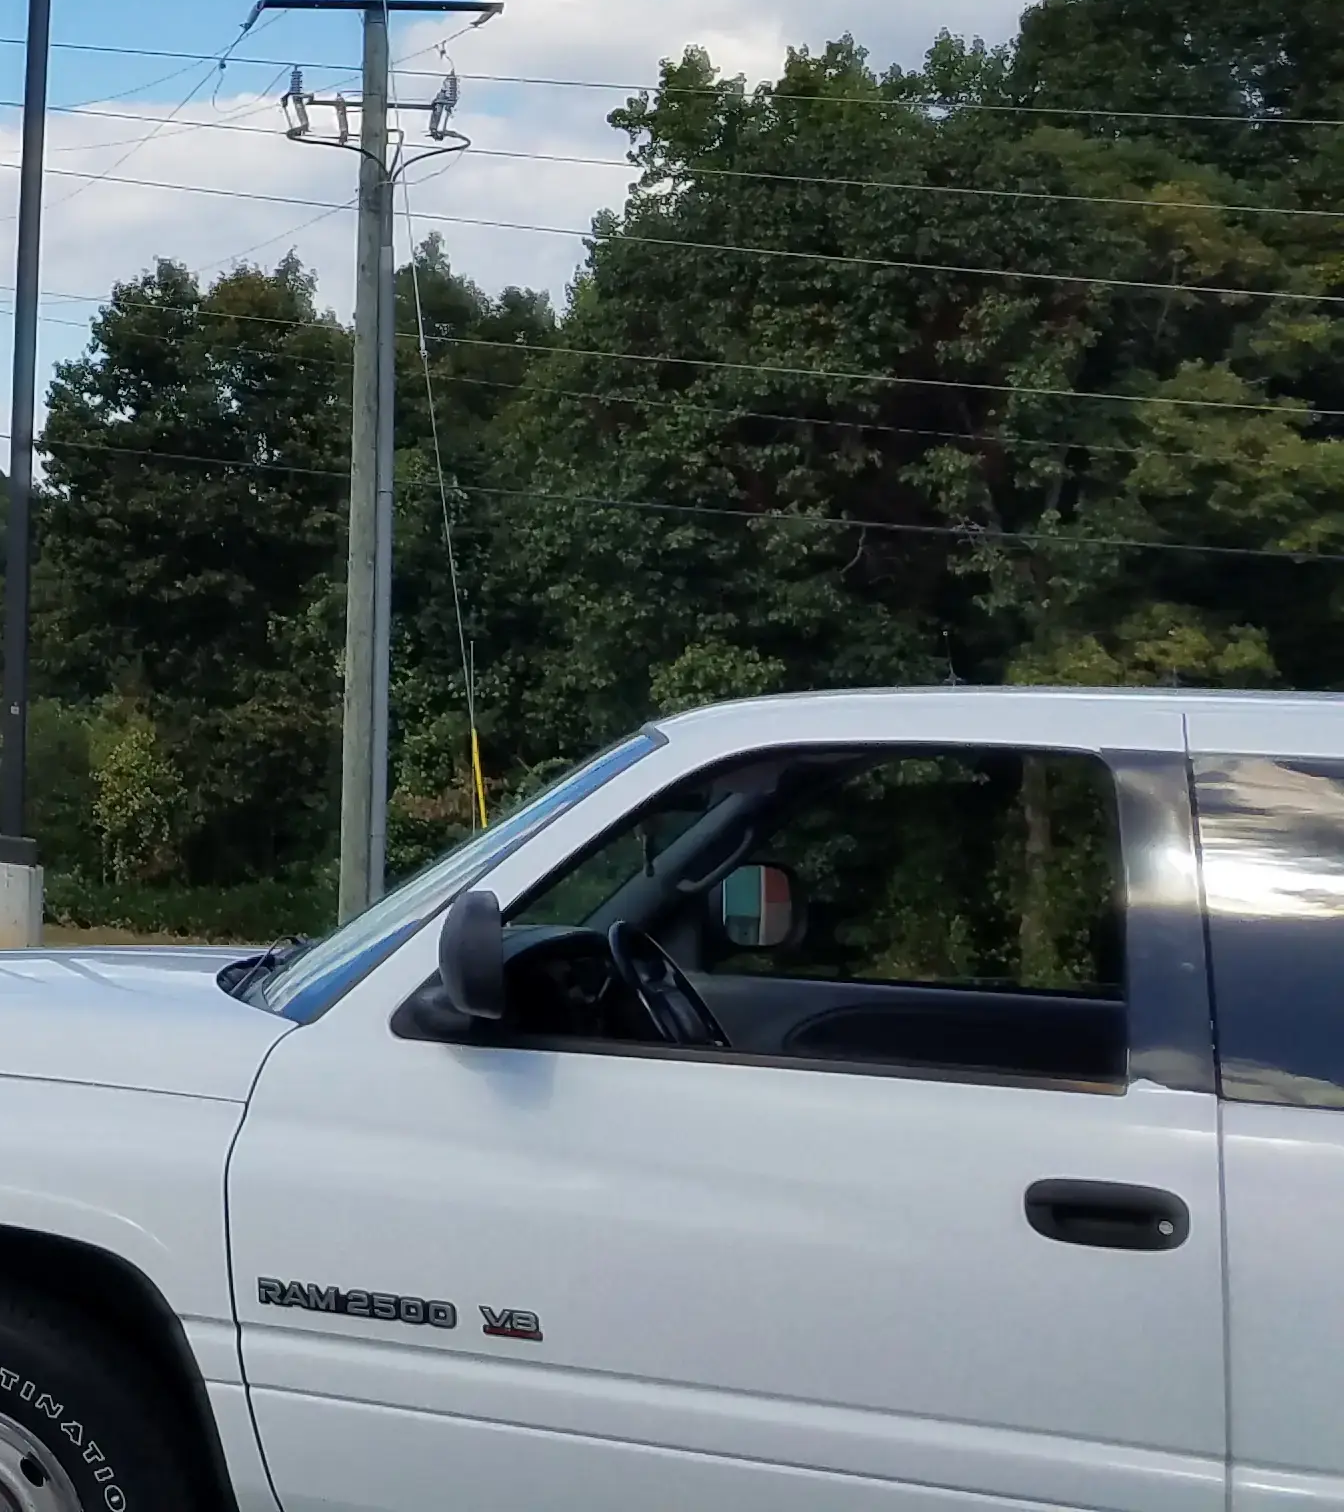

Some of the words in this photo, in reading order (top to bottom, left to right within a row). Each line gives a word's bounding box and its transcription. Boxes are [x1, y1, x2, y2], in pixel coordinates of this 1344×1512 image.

[258, 1277, 341, 1312] RAM
[343, 1289, 458, 1329] 2500
[478, 1305, 541, 1334] V8
